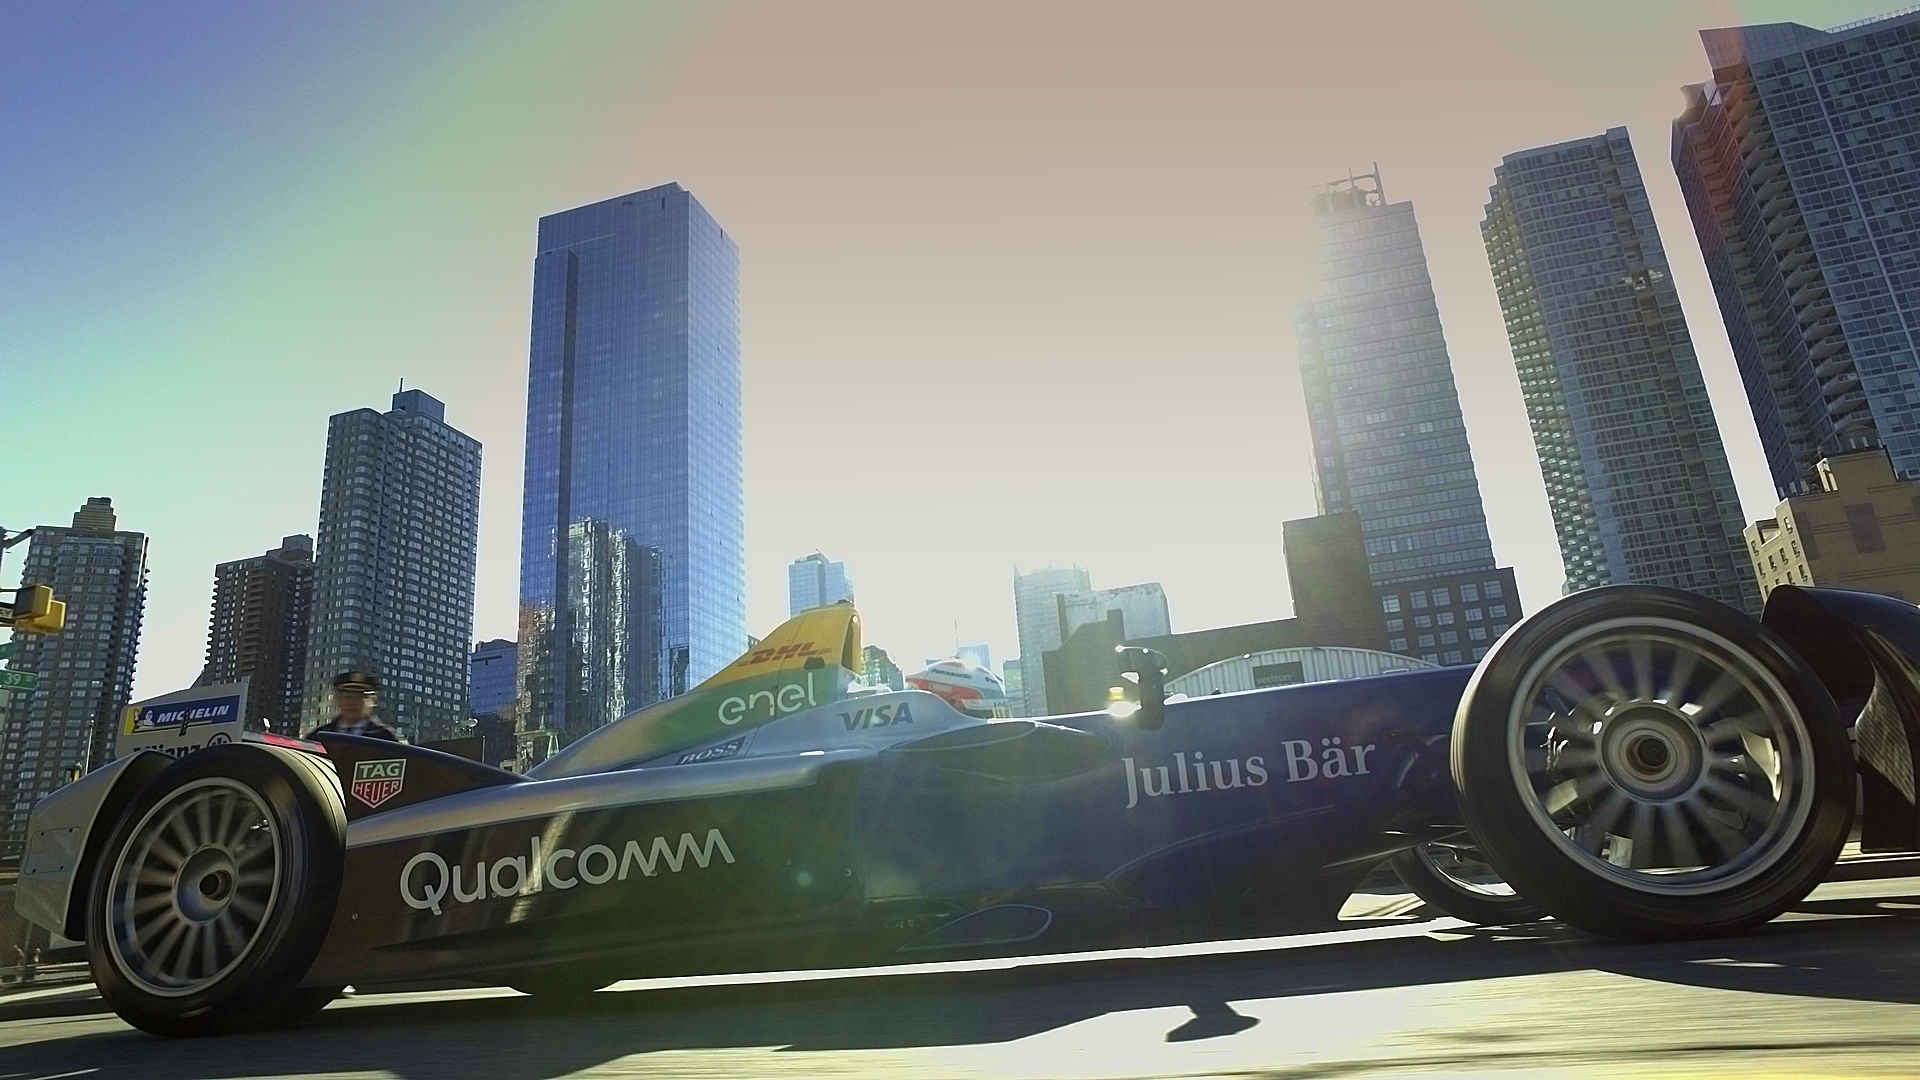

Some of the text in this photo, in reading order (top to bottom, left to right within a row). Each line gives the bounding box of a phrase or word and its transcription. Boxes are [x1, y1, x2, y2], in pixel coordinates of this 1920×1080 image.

[750, 642, 818, 665] DHL
[4, 672, 22, 685] 39
[930, 667, 973, 680] Panasonic
[718, 671, 817, 725] enel
[836, 701, 914, 732] VISA
[680, 740, 739, 765] BOSS
[359, 762, 400, 779] TAG
[1121, 736, 1376, 809] Julius Bär
[355, 780, 400, 803] HEUER
[400, 827, 736, 916] Qualcomm
